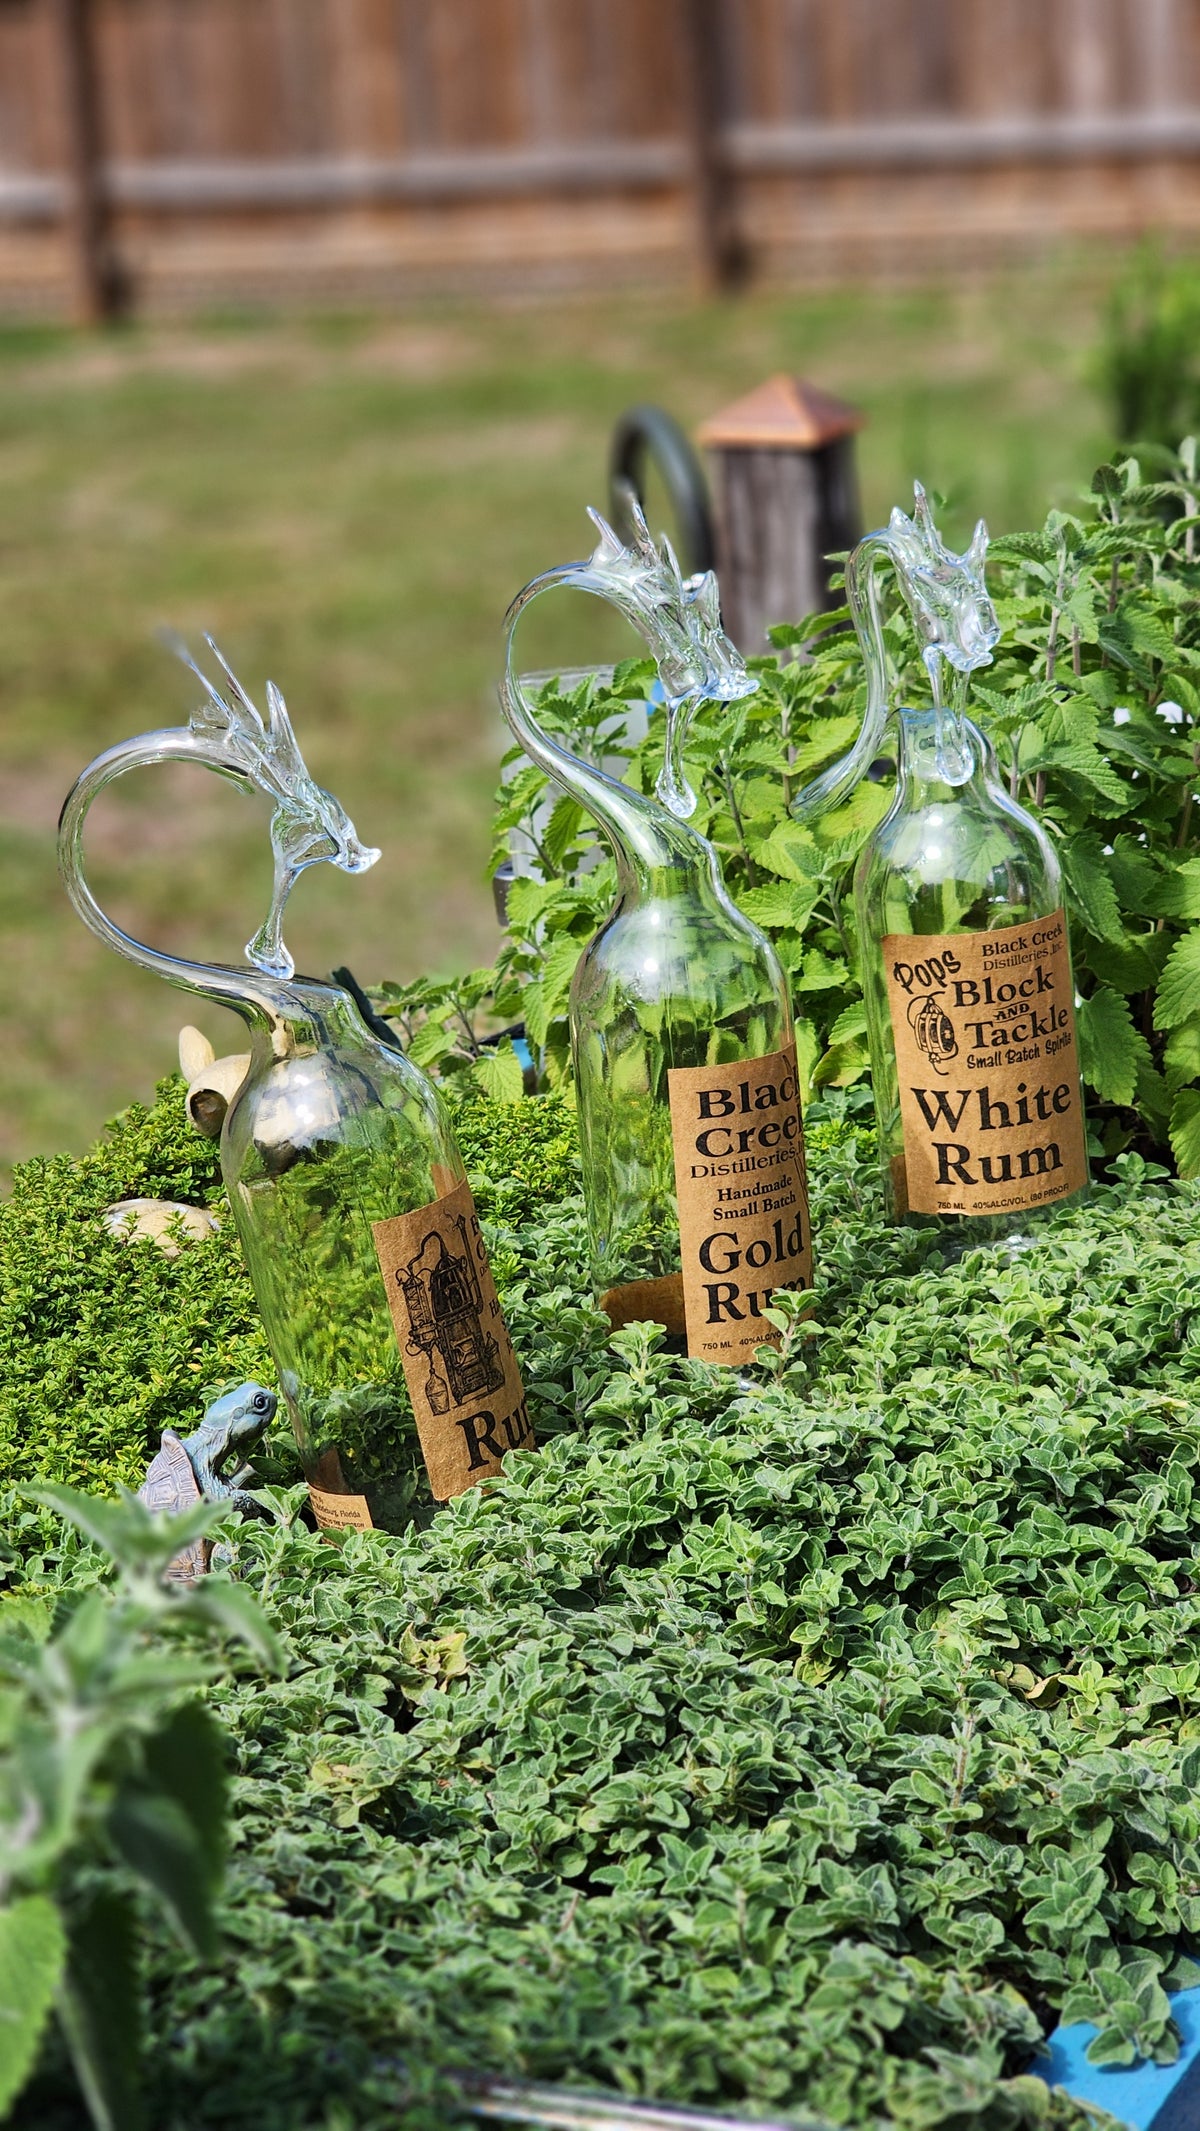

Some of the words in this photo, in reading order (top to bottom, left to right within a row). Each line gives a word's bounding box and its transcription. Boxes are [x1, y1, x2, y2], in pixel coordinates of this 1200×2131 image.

[982, 937, 1028, 957] Black
[1032, 923, 1062, 946] Creek
[893, 950, 961, 995] Pops
[951, 965, 1055, 1007] Block
[964, 1004, 1069, 1049] Tackle
[993, 1003, 1030, 1021] AND
[967, 1052, 1002, 1069] Small
[1005, 1043, 1040, 1065] Batch
[1045, 1032, 1072, 1055] Spirits
[910, 1082, 1072, 1133] White
[931, 1142, 1064, 1185] Rum
[713, 1201, 758, 1221] Small
[762, 1190, 796, 1213] Batch
[717, 1174, 792, 1202] Handmade
[699, 1210, 805, 1275] Gold
[702, 1342, 718, 1350] 750
[739, 1330, 784, 1345] 40%ALC/VO
